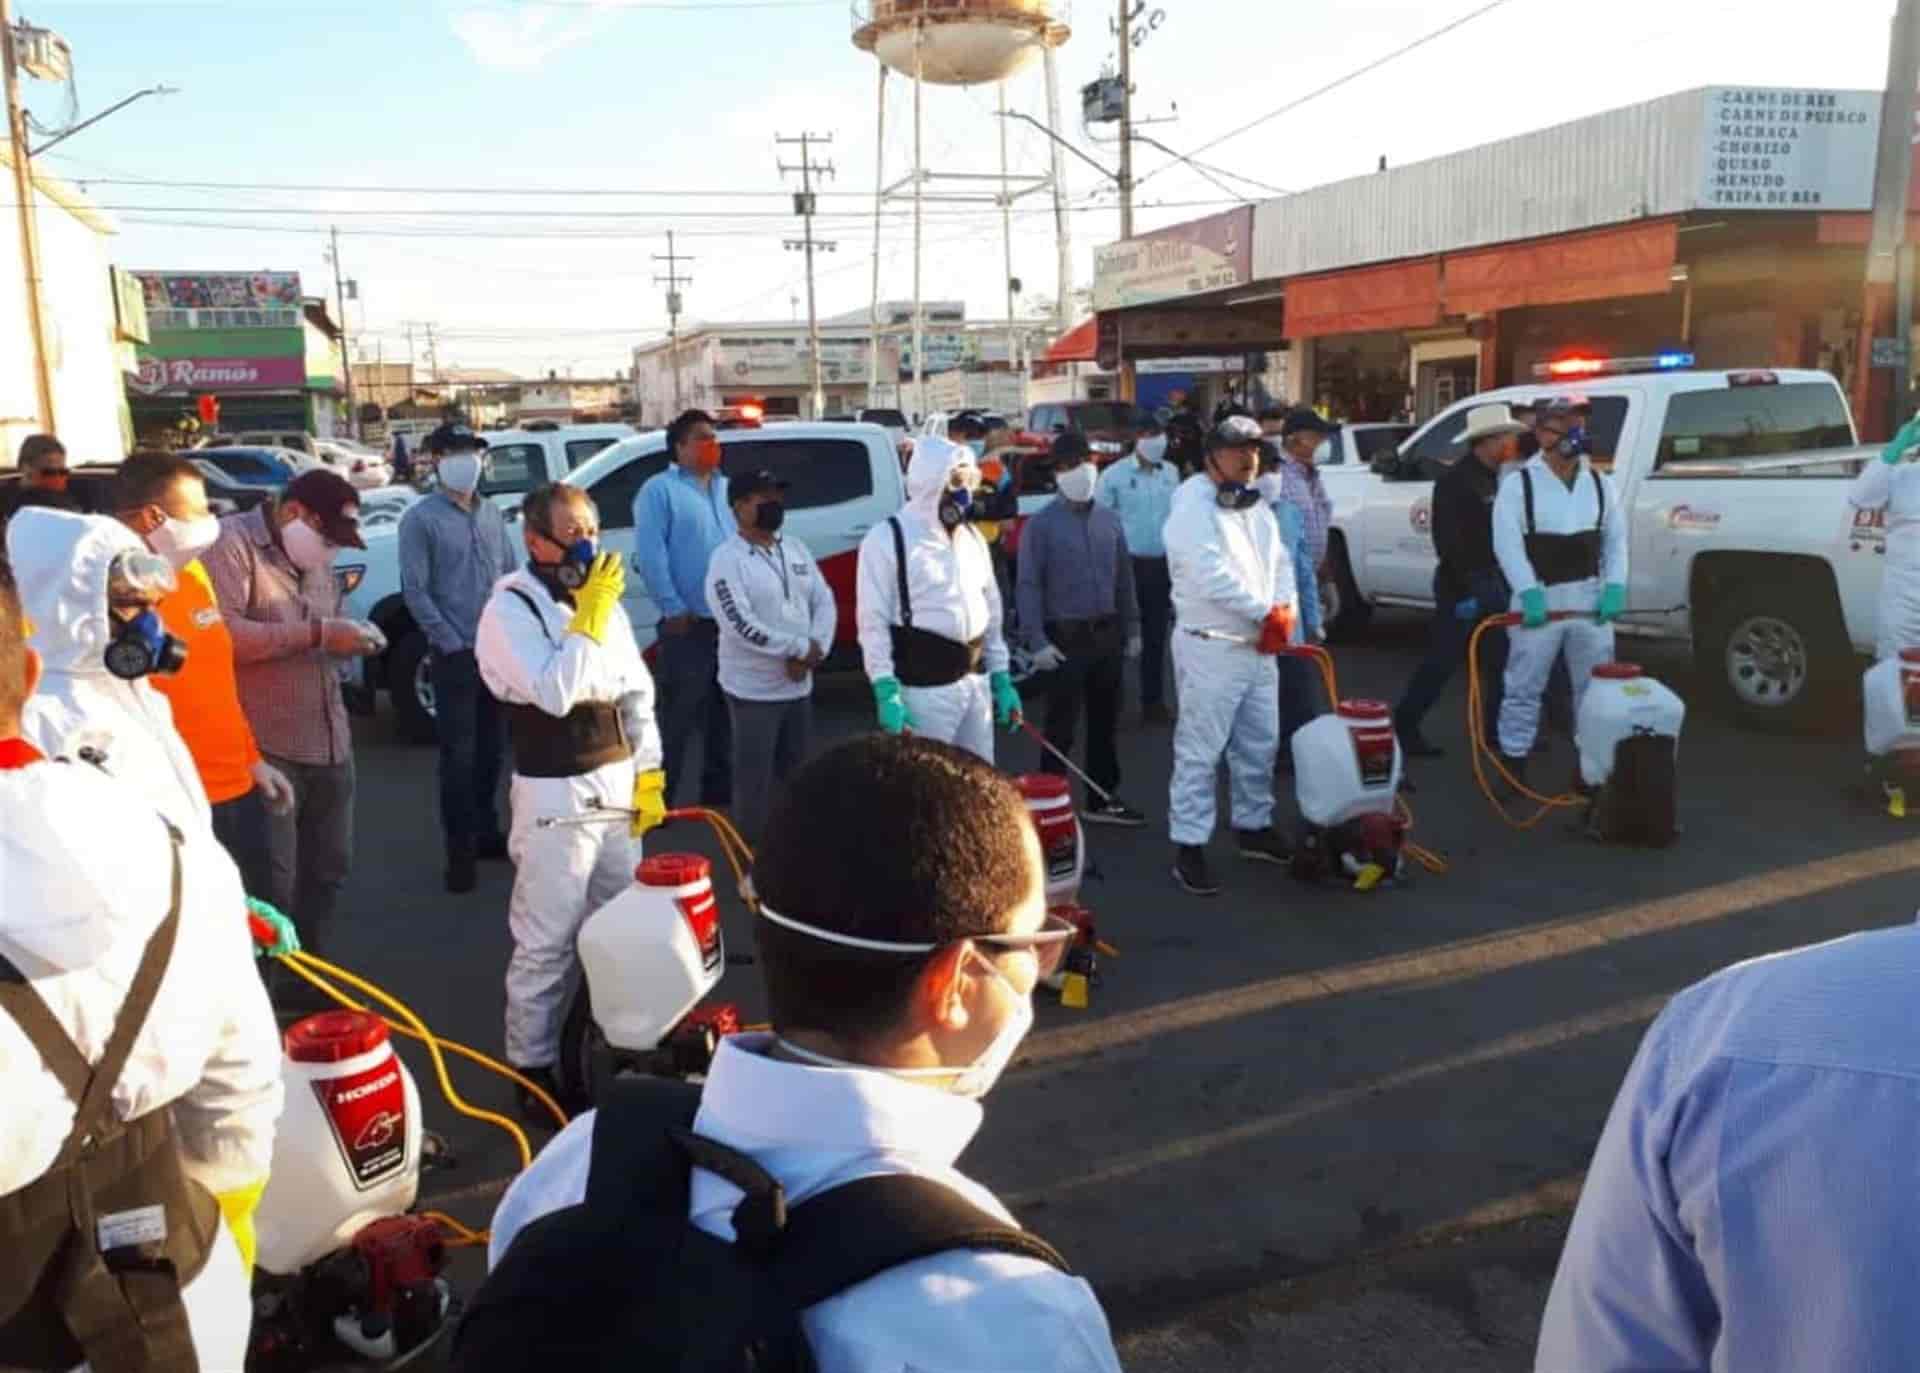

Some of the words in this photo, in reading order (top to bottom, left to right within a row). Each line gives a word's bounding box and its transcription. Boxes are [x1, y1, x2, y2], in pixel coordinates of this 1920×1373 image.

[1781, 92, 1801, 105] DE
[1780, 109, 1801, 122] DE
[1767, 190, 1787, 204] DE
[170, 359, 259, 385] Ramos
